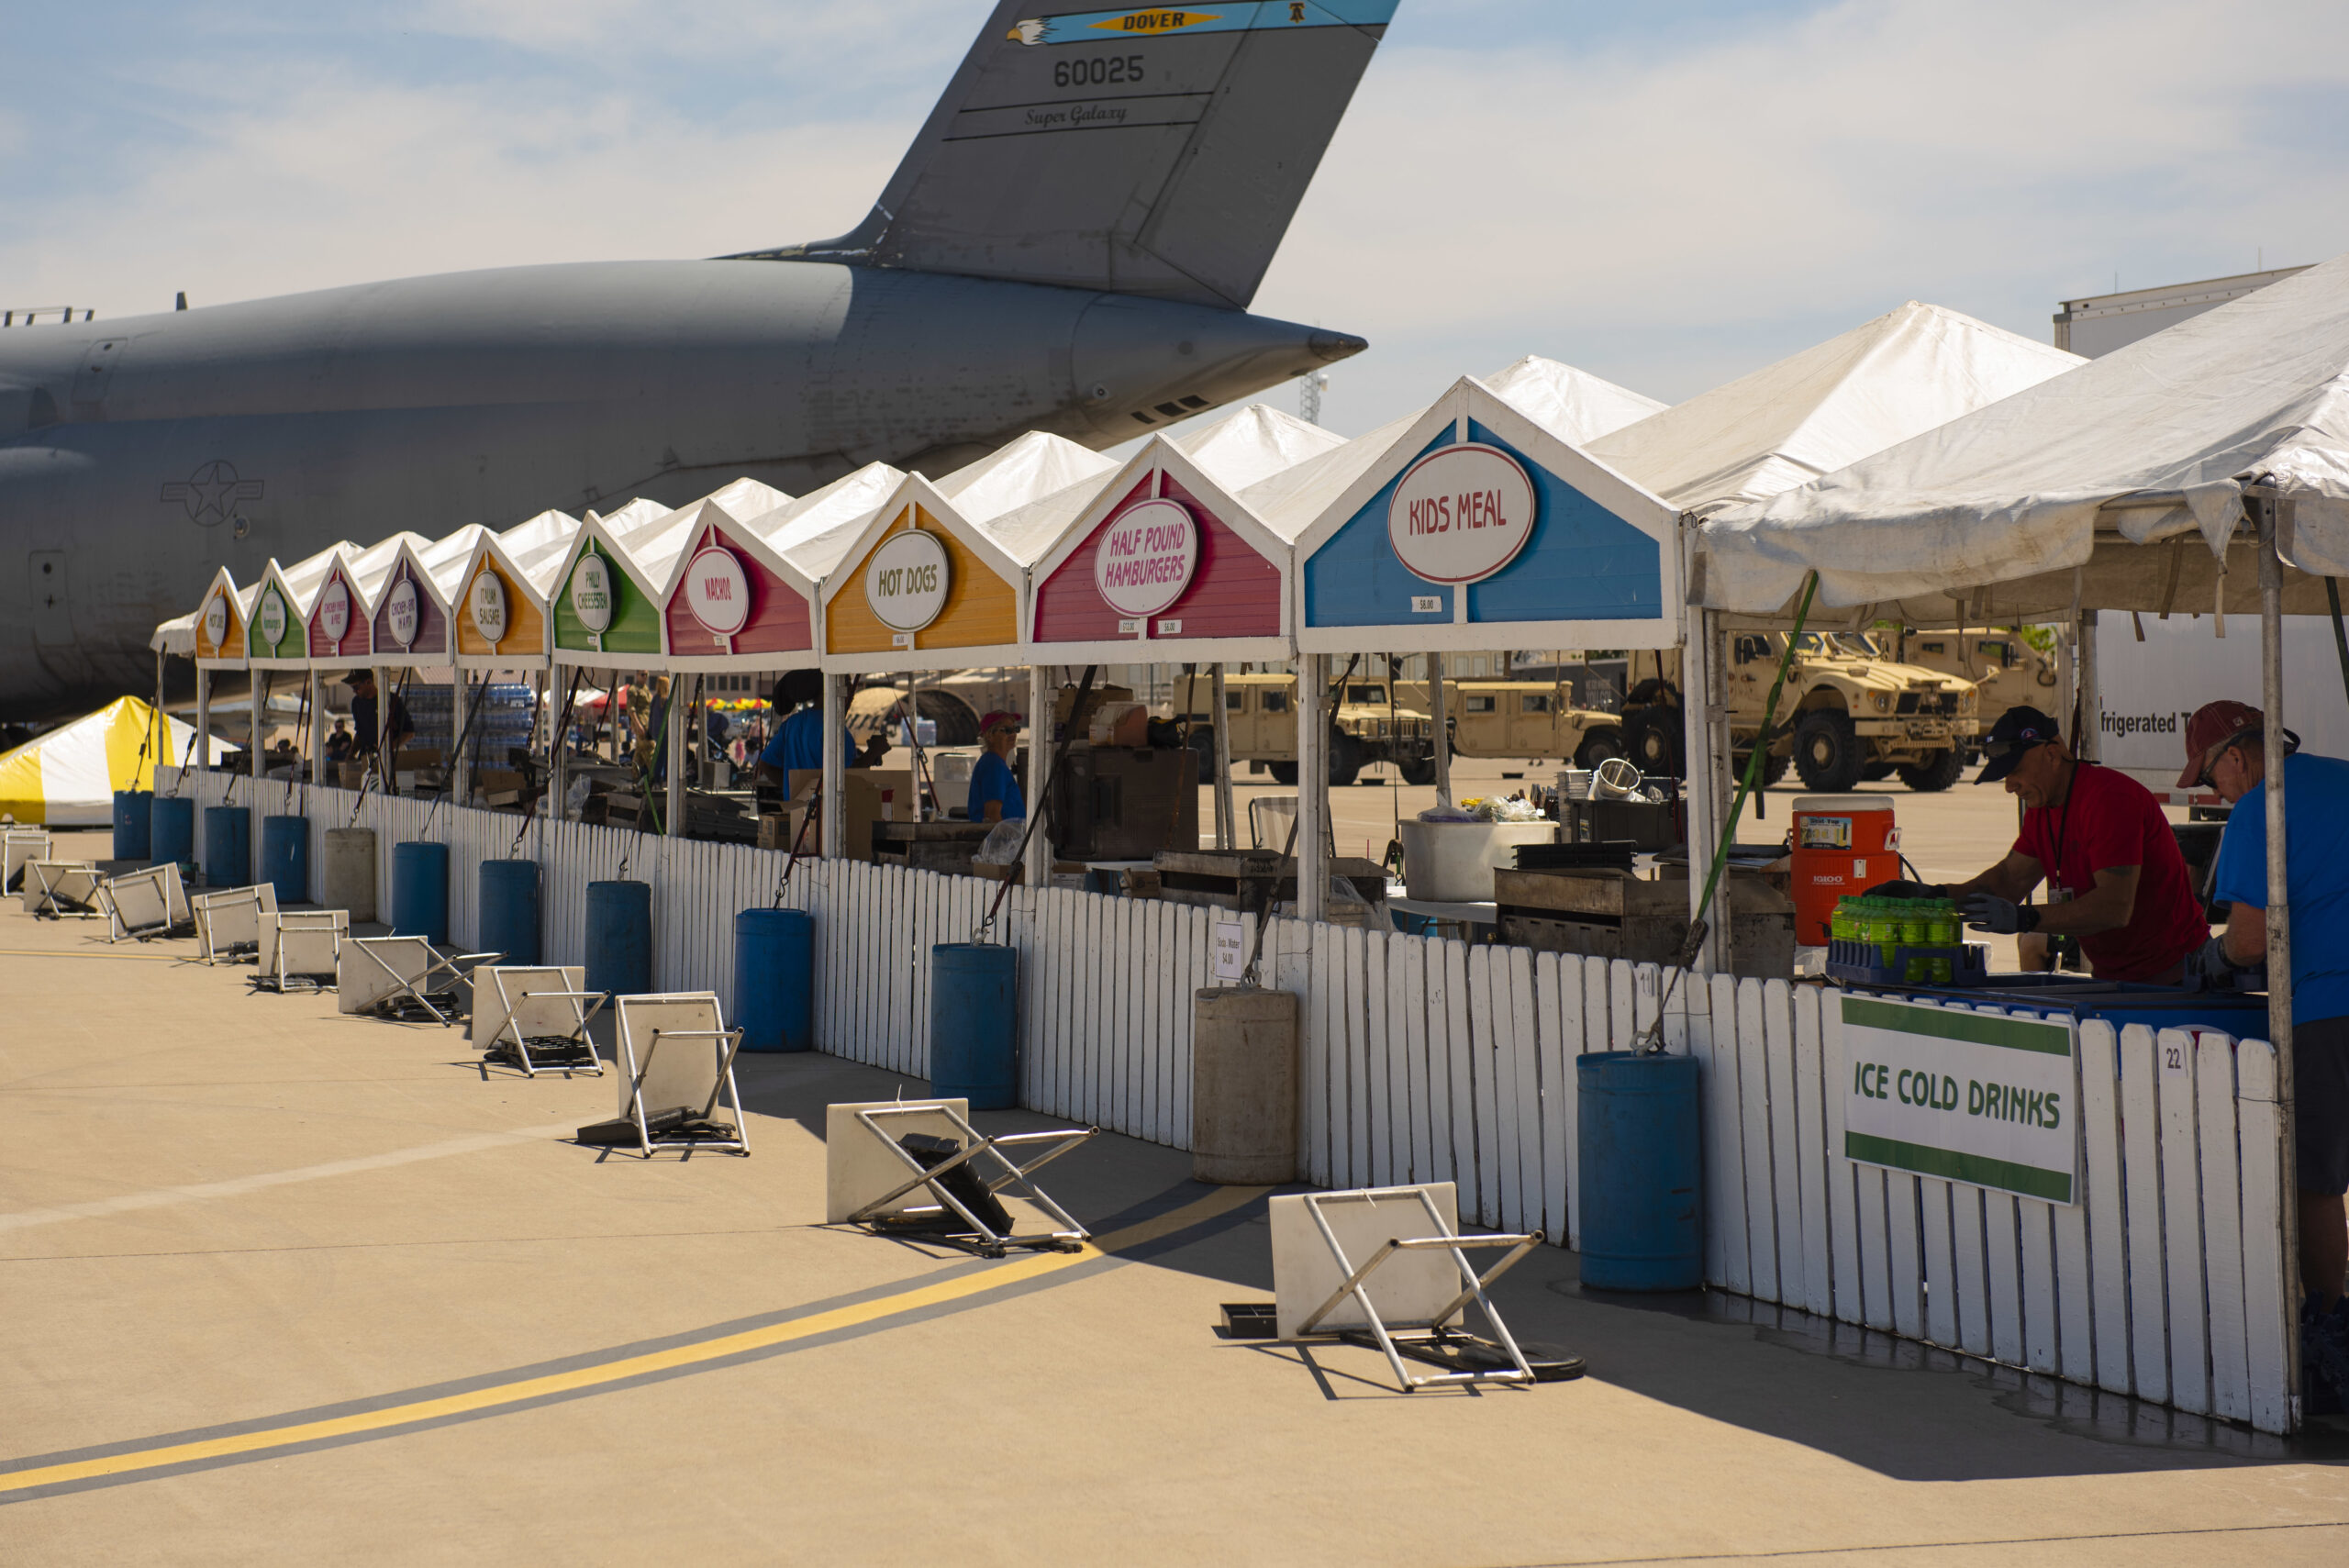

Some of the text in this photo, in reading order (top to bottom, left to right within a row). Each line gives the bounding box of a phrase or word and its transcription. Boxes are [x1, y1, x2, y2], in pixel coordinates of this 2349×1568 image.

[1122, 12, 1186, 30] DOVER
[1054, 54, 1145, 88] 60025
[1024, 104, 1128, 128] Super Galaxy
[1409, 488, 1507, 536] KIDS MEAL
[1110, 522, 1186, 557] HALF POUND
[585, 571, 601, 588] PHILLY
[878, 563, 938, 597] HOT DOGS
[1104, 554, 1186, 588] HAMBURGERS
[704, 576, 732, 602] NACHOS
[479, 607, 500, 626] SAUSAGE
[2100, 711, 2176, 738] frigerated
[1813, 874, 1842, 883] IGLOO
[2166, 1047, 2182, 1070] 22
[1854, 1061, 2061, 1130] ICE COLD DRINKS
